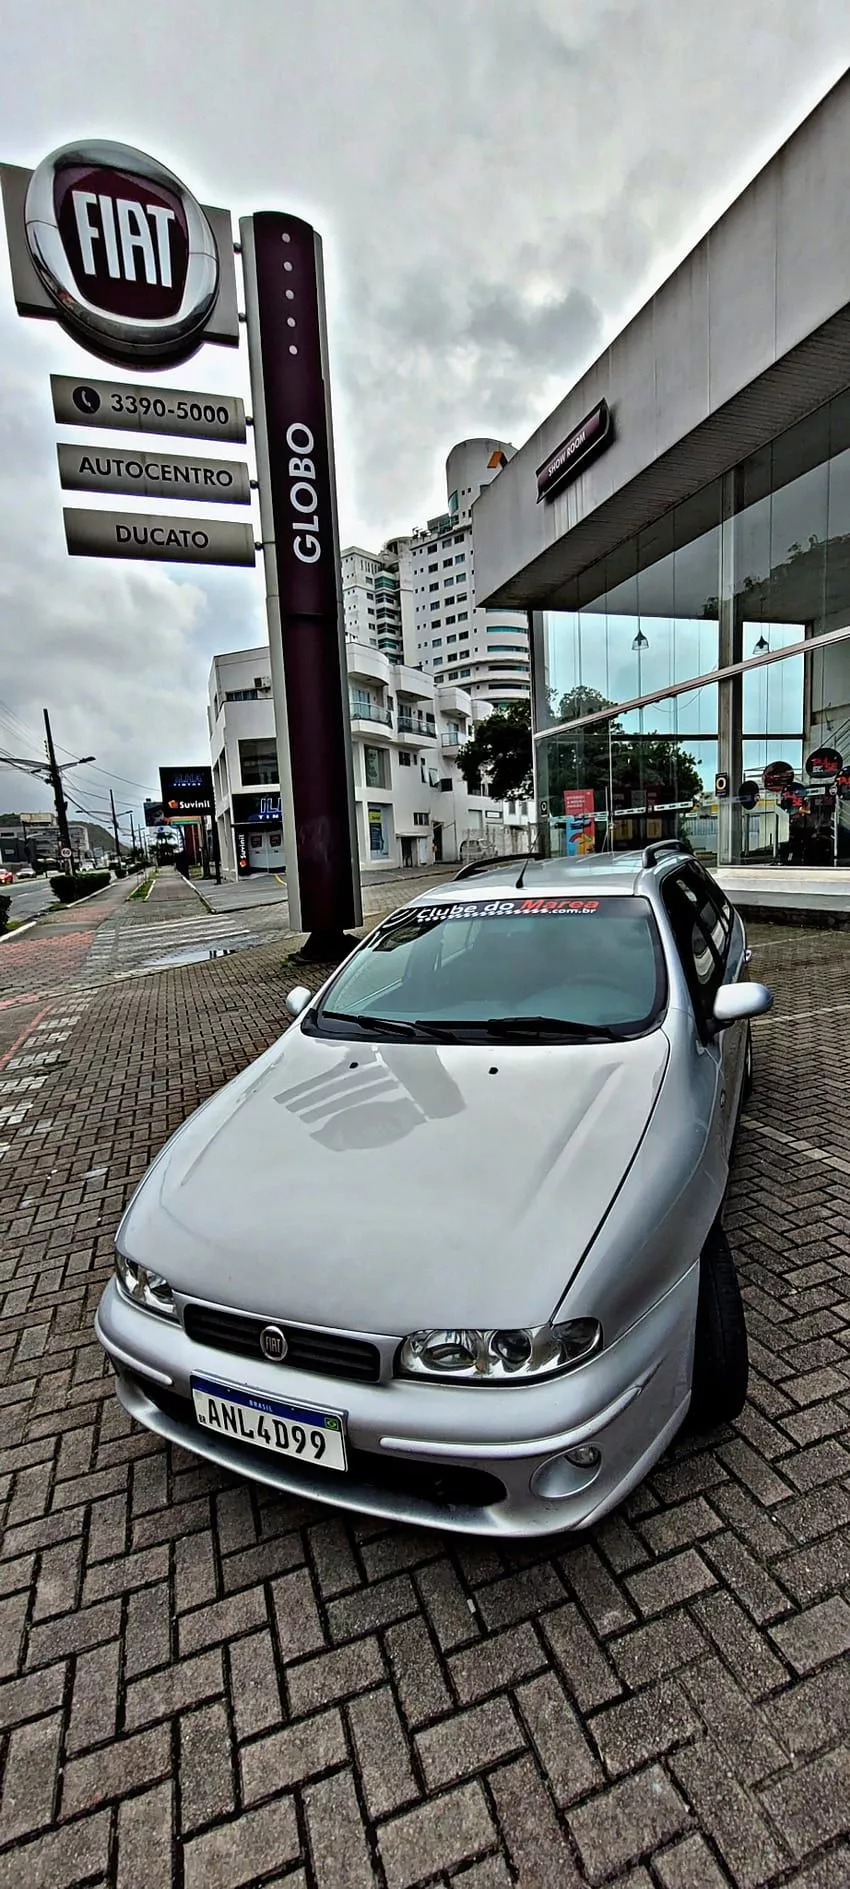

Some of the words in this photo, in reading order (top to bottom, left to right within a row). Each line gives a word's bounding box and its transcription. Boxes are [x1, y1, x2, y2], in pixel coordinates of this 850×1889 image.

[72, 190, 175, 288] FIAT
[110, 393, 229, 425] 3390-5000
[548, 450, 566, 477] SHOW
[566, 431, 586, 458] ROOM
[79, 456, 233, 487] AUTOCENTRO
[286, 422, 322, 564] GLOBO
[115, 524, 209, 549] DUCATO
[179, 799, 211, 809] Suvinil
[416, 903, 479, 919] Clube
[484, 901, 515, 913] do
[519, 899, 600, 910] Marea
[548, 907, 597, 915] .com.br
[265, 1336, 281, 1353] FIAT
[249, 1399, 273, 1413] BRASIL
[207, 1398, 326, 1460] ANL4D99
